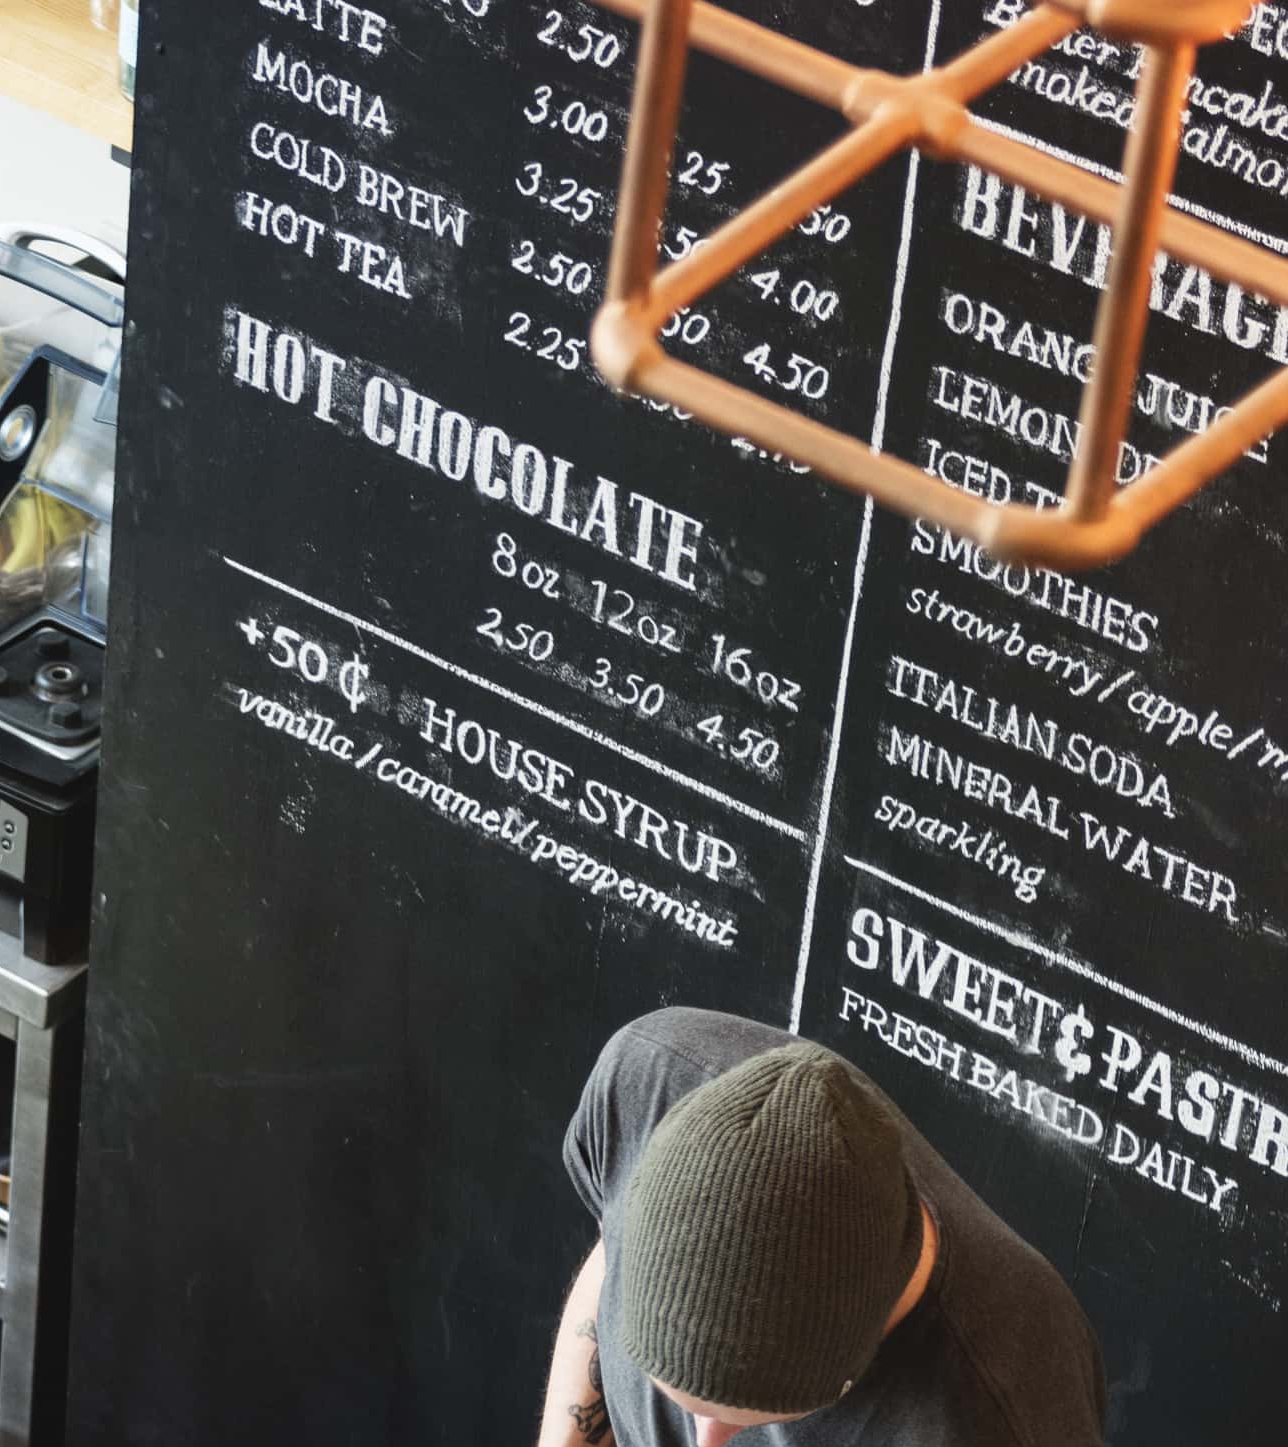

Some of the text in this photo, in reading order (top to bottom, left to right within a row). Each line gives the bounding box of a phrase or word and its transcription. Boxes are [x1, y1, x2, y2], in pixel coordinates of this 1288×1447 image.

[523, 85, 608, 142] 3.00
[537, 10, 622, 69] 2.50
[250, 122, 345, 192] COLD
[357, 166, 471, 247] BREW
[511, 241, 592, 295] 2.50
[743, 342, 830, 400] 4.50
[252, 42, 393, 137] MOCHA
[516, 163, 601, 222] 3.25
[751, 267, 840, 322] 4.00
[241, 192, 586, 371] HOT TEA 2.25
[944, 293, 1098, 384] ORANG
[233, 311, 703, 592] HOT CHOCOLATE
[923, 437, 1011, 506] ICED
[476, 608, 780, 770] 2.50 3.50 4.50
[887, 655, 1177, 819] ITALIAN SODA
[419, 698, 572, 812] HOUSE
[579, 779, 739, 883] SYRUP
[874, 795, 1045, 903] sparkling
[885, 725, 1240, 922] MINERAL WATER
[846, 907, 1062, 1055] SWEET
[839, 987, 1238, 1211] FRESH BAKED DAILY
